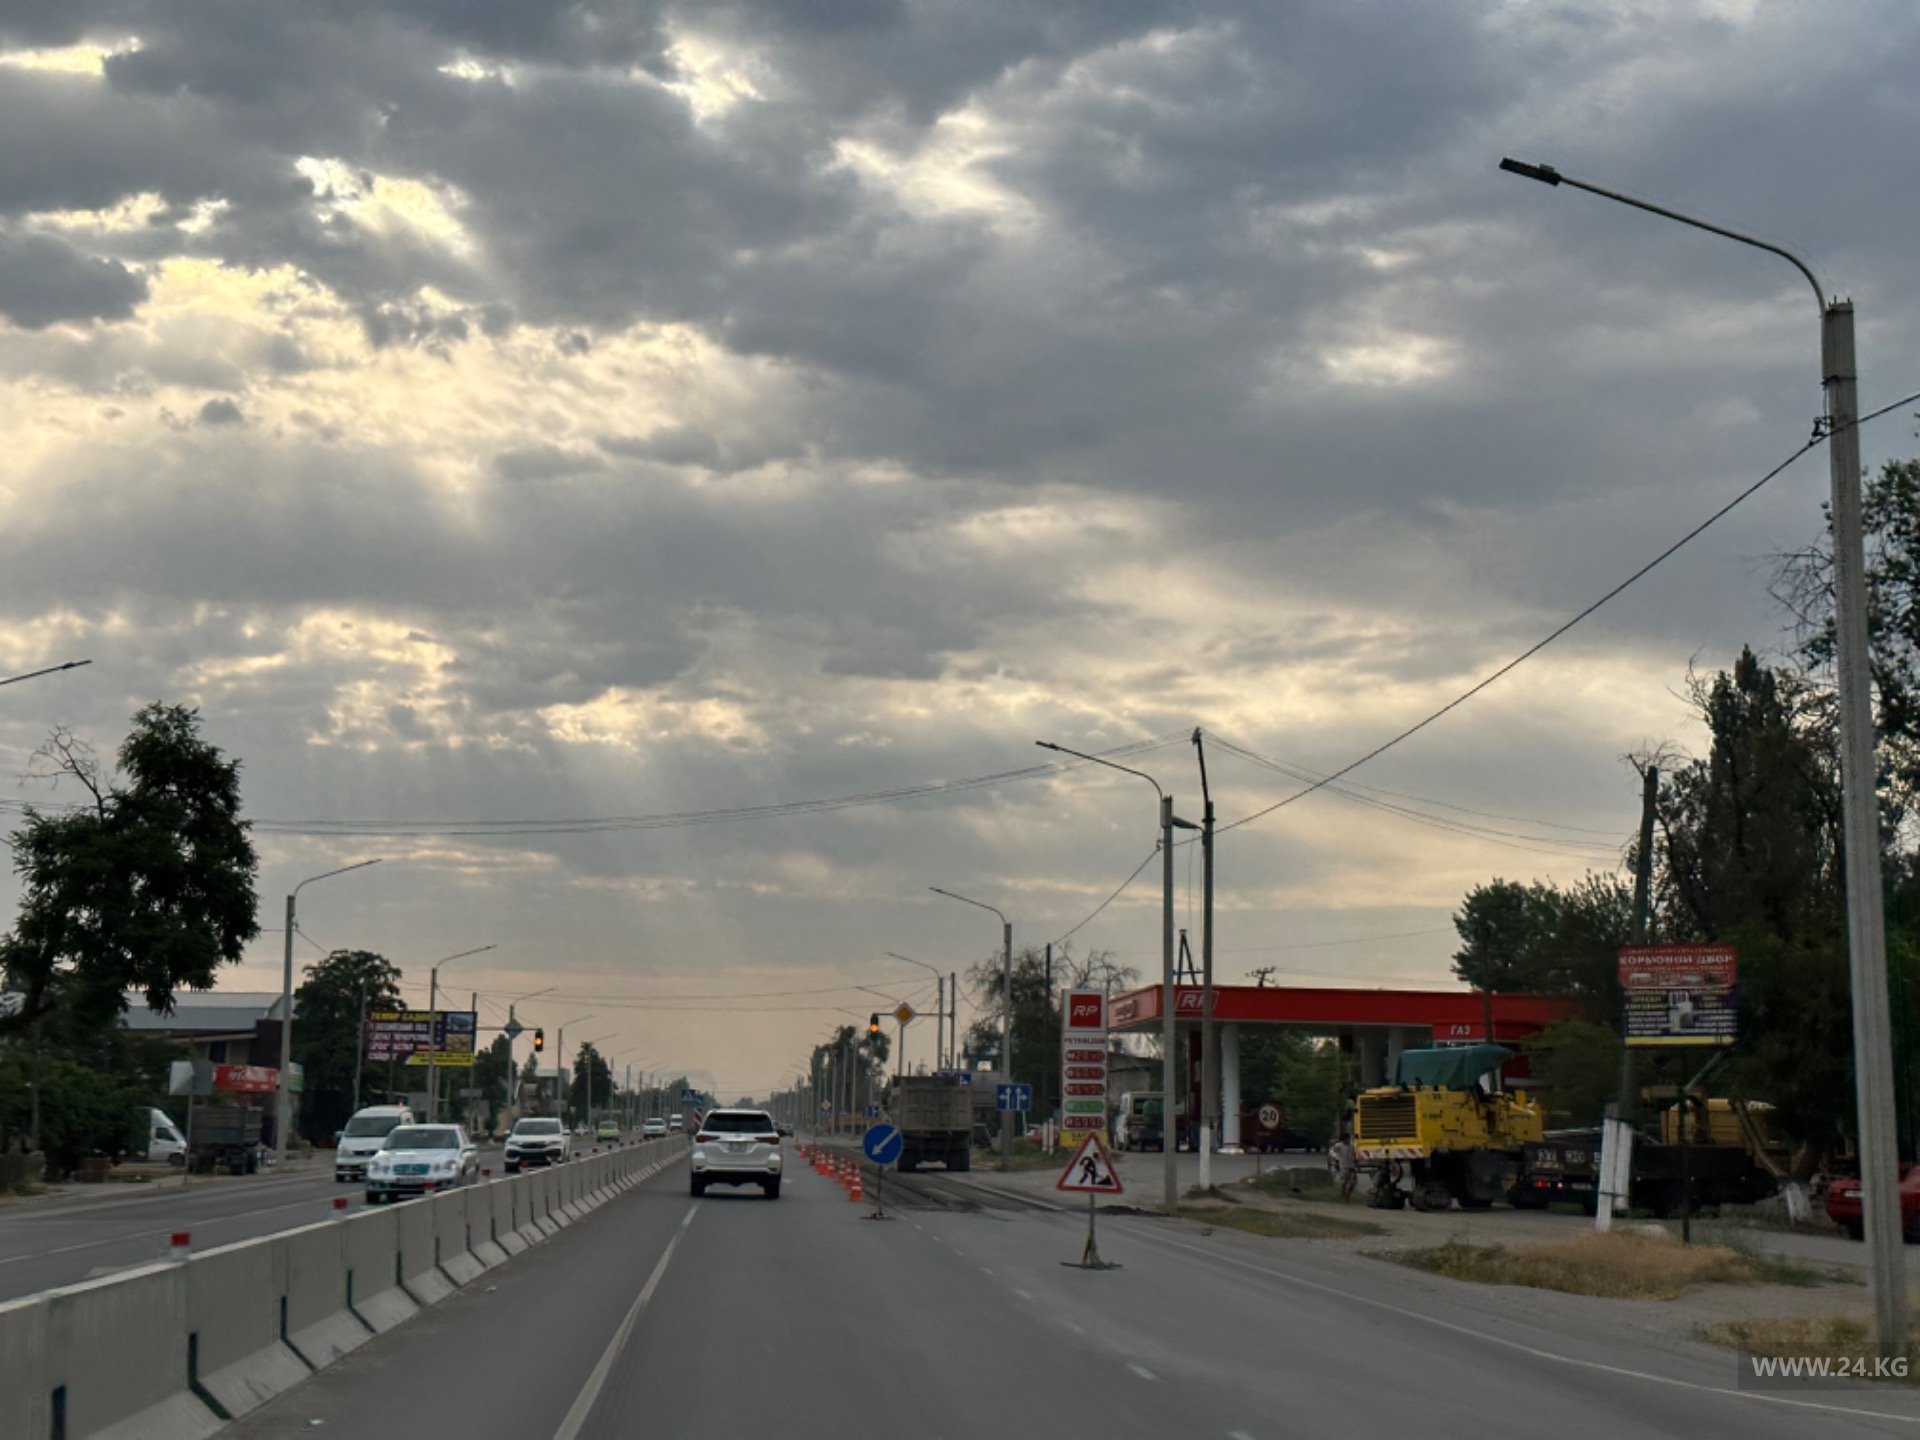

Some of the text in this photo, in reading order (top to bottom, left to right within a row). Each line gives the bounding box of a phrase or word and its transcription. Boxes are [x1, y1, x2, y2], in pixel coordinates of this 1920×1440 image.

[1073, 1004, 1098, 1017] RP
[1450, 1024, 1472, 1036] ГАЗ
[1262, 1110, 1277, 1121] 20
